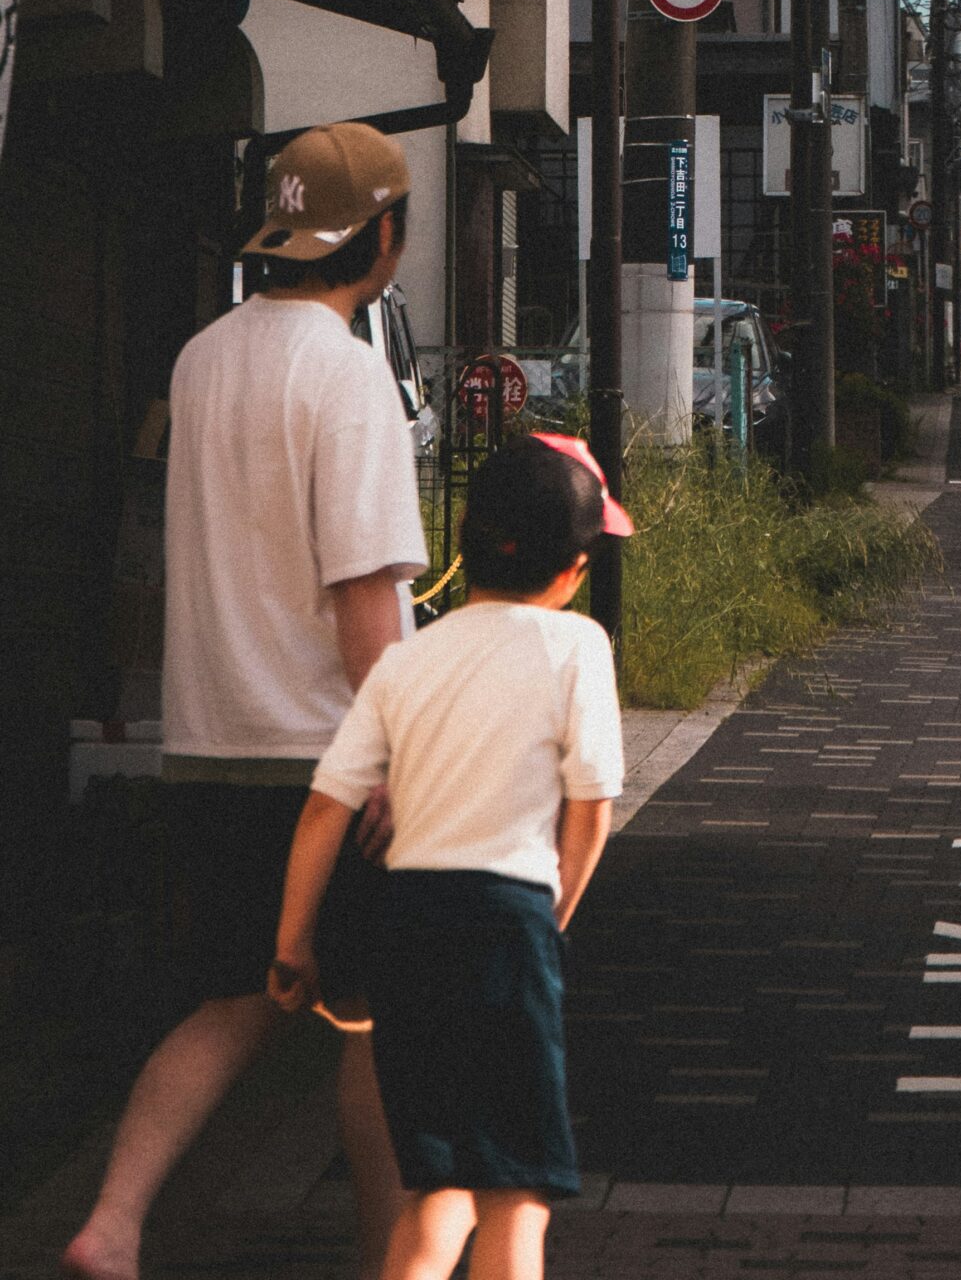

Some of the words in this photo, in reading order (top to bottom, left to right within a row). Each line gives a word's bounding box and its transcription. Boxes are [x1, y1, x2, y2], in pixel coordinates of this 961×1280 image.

[279, 173, 305, 214] NY
[675, 156, 686, 230] 下吉田二丁目
[672, 233, 687, 249] 13
